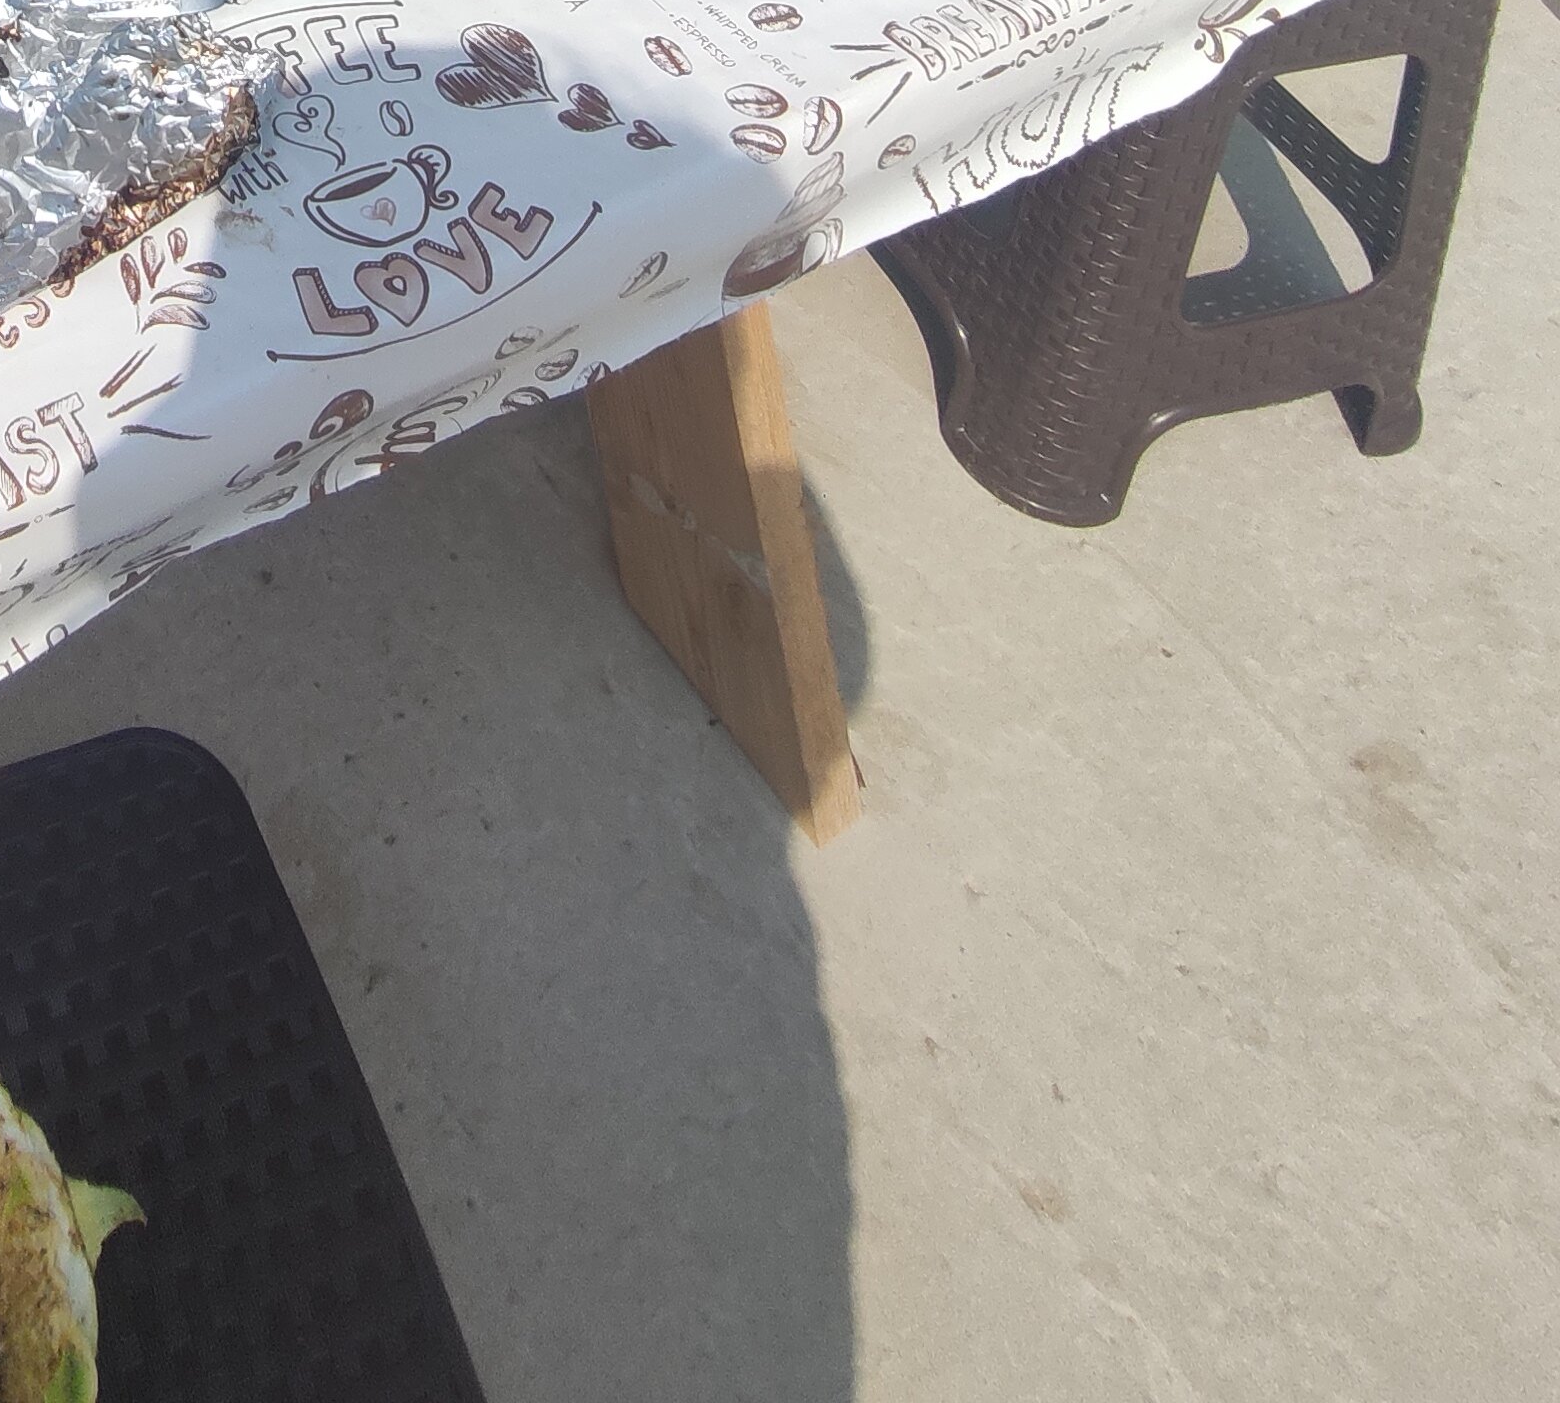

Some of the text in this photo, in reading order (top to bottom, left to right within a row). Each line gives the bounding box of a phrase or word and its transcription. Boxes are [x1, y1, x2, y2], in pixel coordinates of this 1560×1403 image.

[673, 16, 737, 70] ESPRESSO
[703, 3, 808, 90] WHIPPED CREAM
[217, 150, 289, 205] with
[292, 181, 554, 337] LOVE
